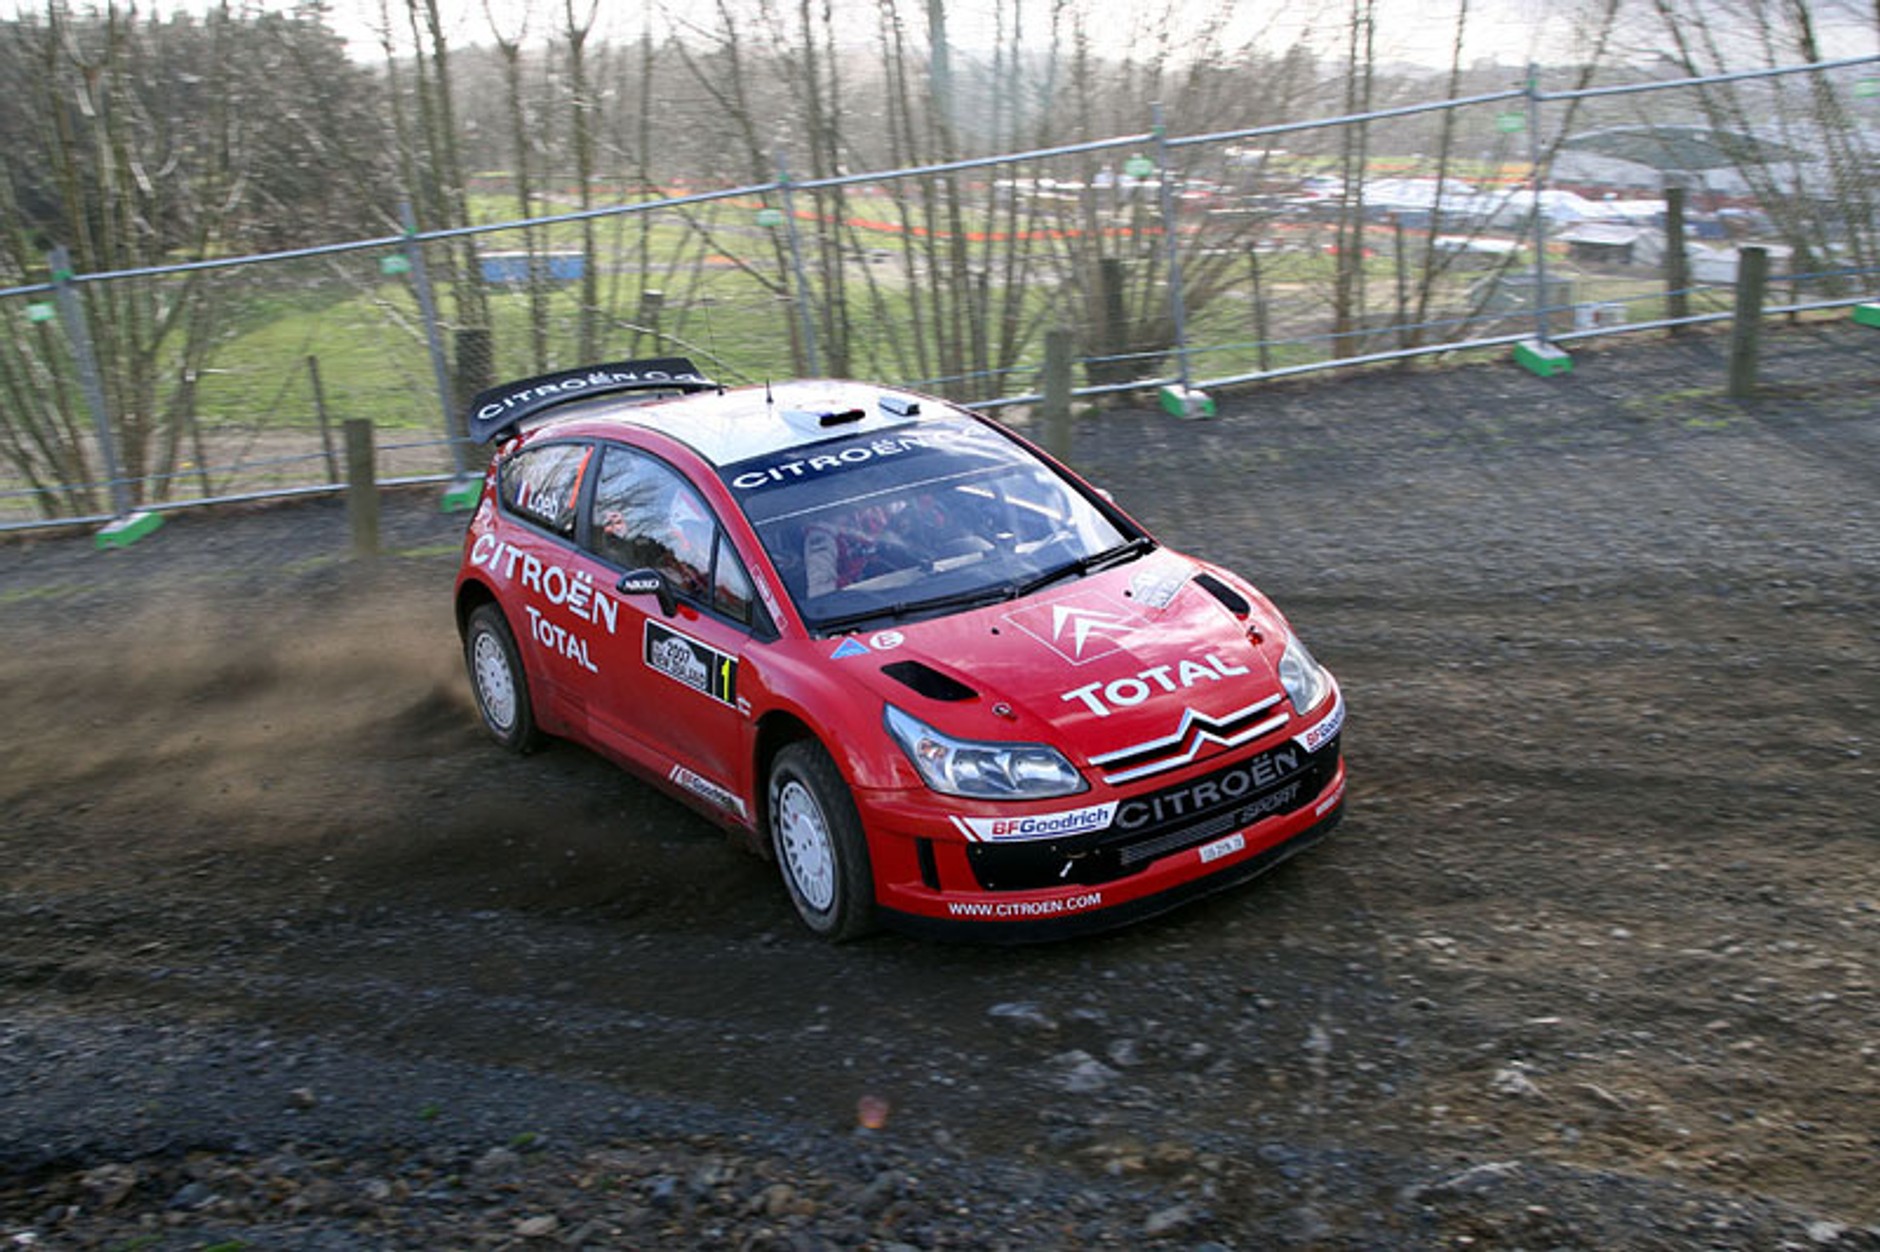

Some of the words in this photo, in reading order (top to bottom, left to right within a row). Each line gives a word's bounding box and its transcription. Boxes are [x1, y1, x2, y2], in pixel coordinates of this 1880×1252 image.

[470, 533, 619, 635] CITROËN
[525, 605, 599, 673] TOTAL
[721, 658, 730, 703] 1
[1061, 654, 1249, 717] TOTAL
[1115, 748, 1299, 829] CITROËN
[992, 808, 1108, 835] BFGoodrich
